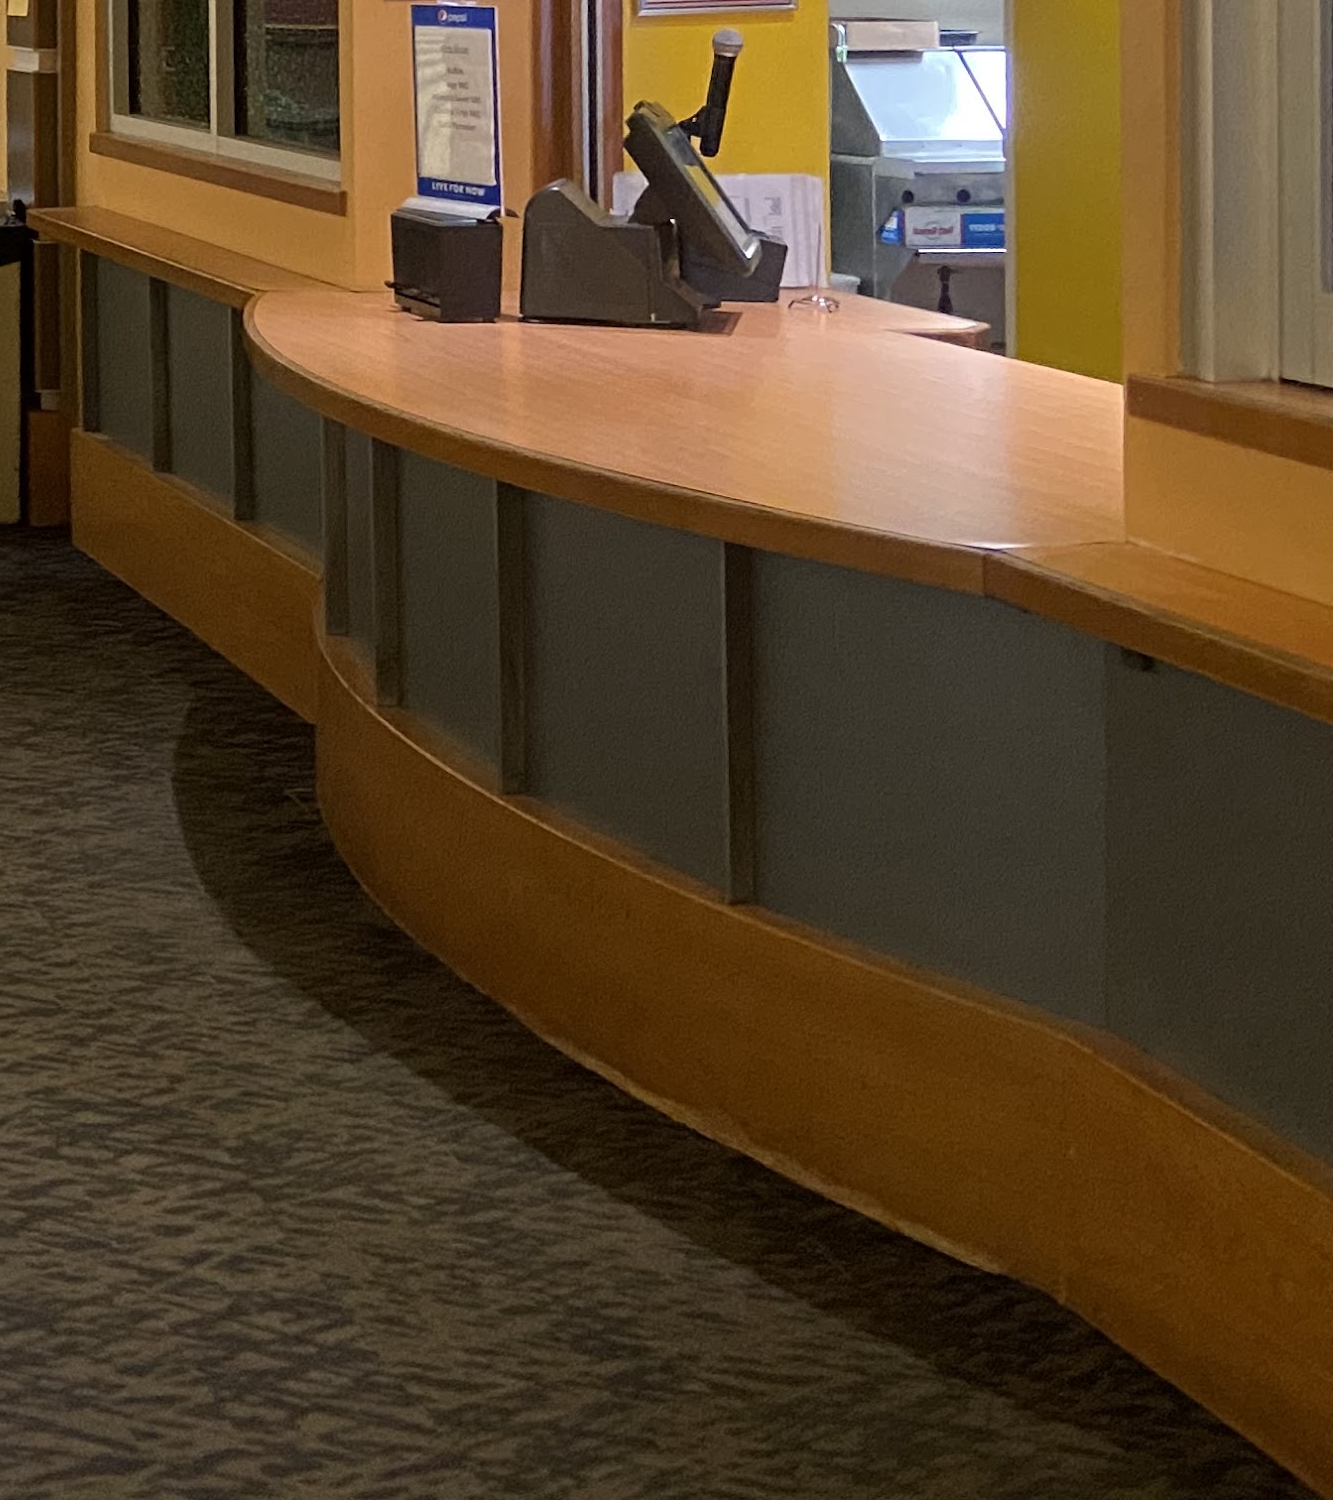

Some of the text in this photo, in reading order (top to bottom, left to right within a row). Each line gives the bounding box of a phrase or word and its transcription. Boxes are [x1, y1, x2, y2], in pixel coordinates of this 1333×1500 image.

[431, 181, 485, 197] LIVE FOR NOW
